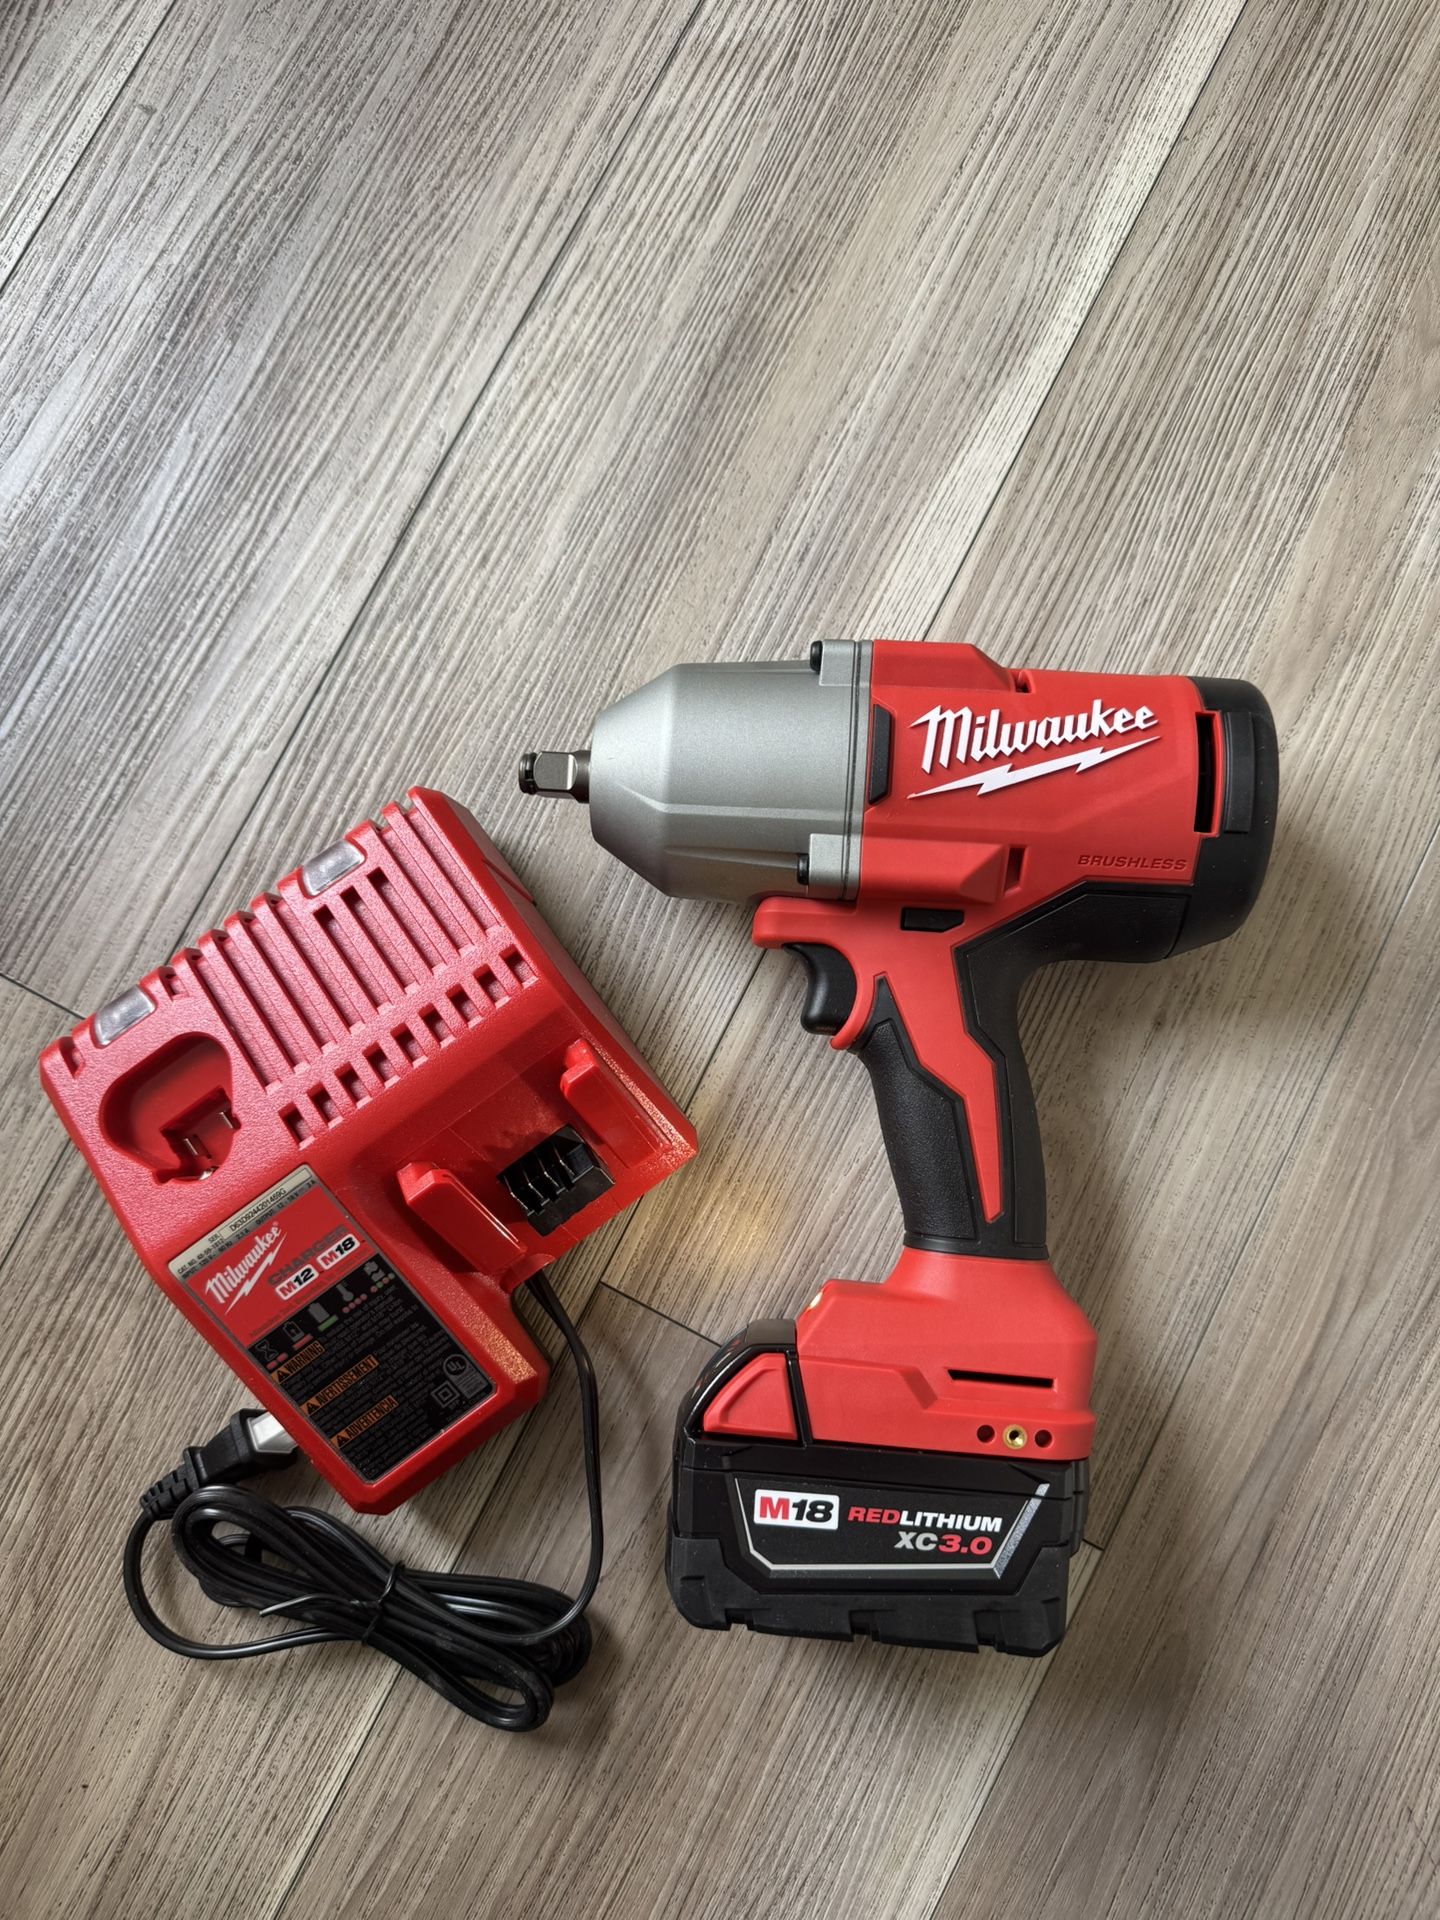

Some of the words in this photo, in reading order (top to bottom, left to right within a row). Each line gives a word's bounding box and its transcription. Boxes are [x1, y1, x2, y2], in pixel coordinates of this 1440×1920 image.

[908, 699, 1159, 774] Milwaukee
[1077, 854, 1188, 871] BRUSHLESS
[205, 1226, 282, 1304] Milwaukee
[268, 1224, 348, 1286] CHARGER
[279, 1268, 315, 1298] M12
[321, 1237, 356, 1266] M18
[285, 1342, 324, 1376] WARNING
[317, 1357, 377, 1406] AVERTISSEMENT
[346, 1396, 398, 1440] ADVERTENCIA
[759, 1496, 835, 1523] M18
[894, 1531, 992, 1555] XC3.0
